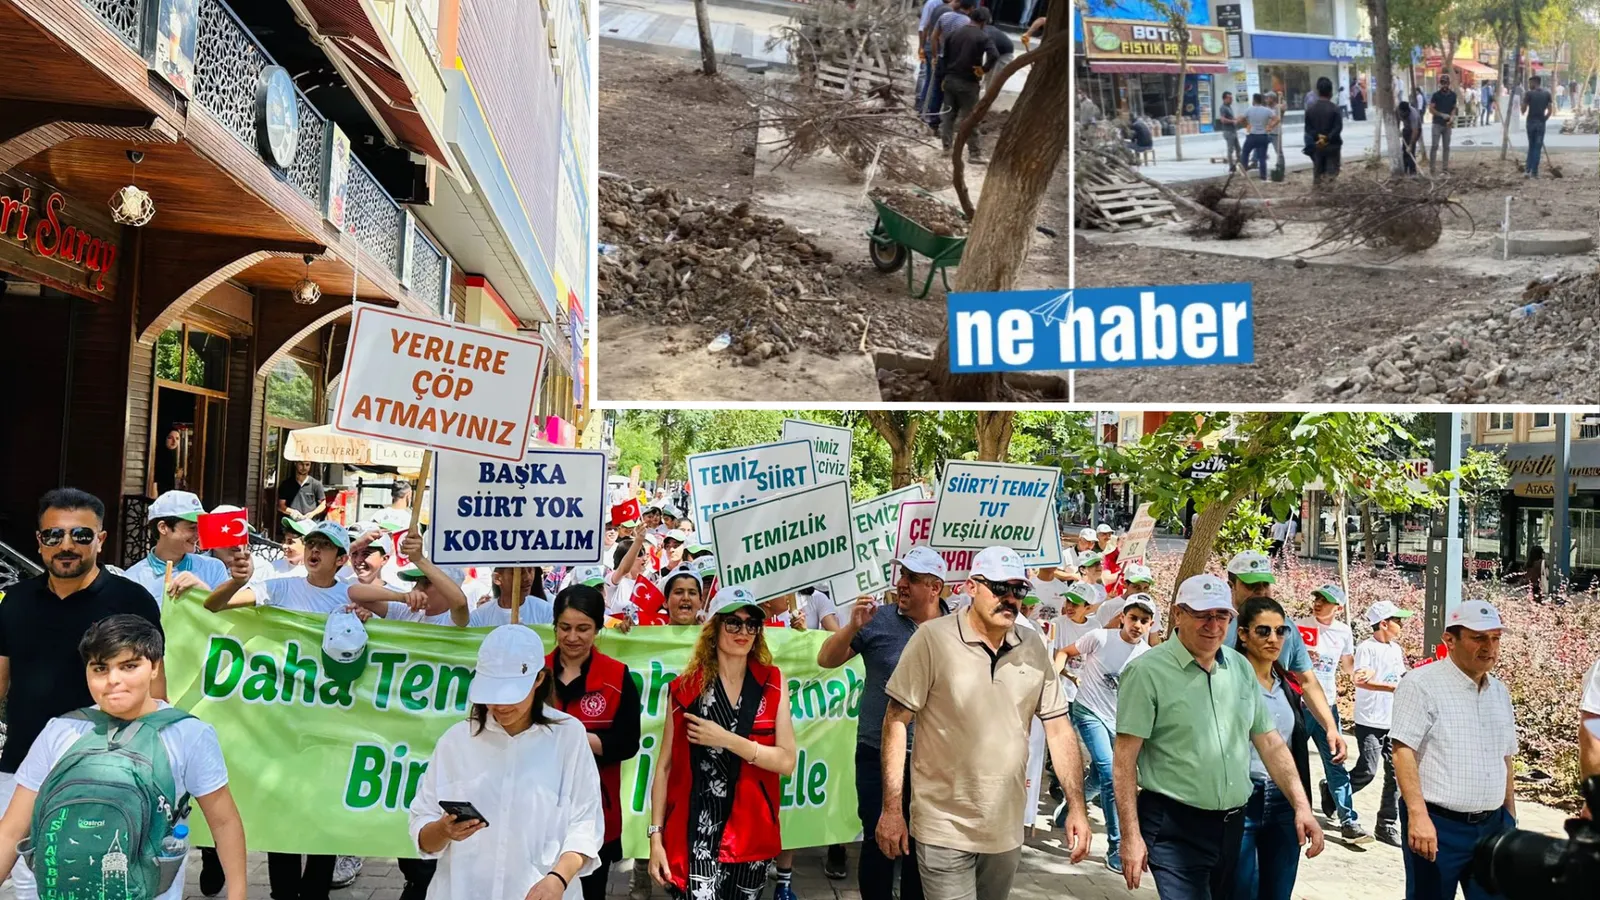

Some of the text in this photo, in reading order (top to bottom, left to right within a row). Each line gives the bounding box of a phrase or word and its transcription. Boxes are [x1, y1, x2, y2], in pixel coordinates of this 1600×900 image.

[0, 187, 117, 291] ri Saray
[391, 328, 509, 375] YERLERE
[412, 367, 474, 401] ÇÖP
[351, 394, 517, 446] ATMAYINIZ
[383, 449, 398, 458] LA
[814, 436, 840, 456] İMİZ
[478, 462, 567, 490] BAŞKA
[698, 456, 807, 492] TEMİZ SİİRT
[816, 458, 846, 476] CİYİZ
[947, 472, 1050, 498] SİİRT'İ TEMİZ
[1525, 483, 1555, 494] ATASA
[457, 491, 584, 518] SİİRT YOK
[853, 502, 900, 533] EMİZ
[979, 501, 1010, 518] TUT
[443, 529, 595, 552] KORUYALIM
[741, 512, 828, 554] TEMİZLİK
[942, 519, 1036, 543] YEŞİLİ KORU
[727, 535, 848, 586] İMANDANDIR
[370, 651, 476, 711] Tem
[787, 668, 865, 719] anab
